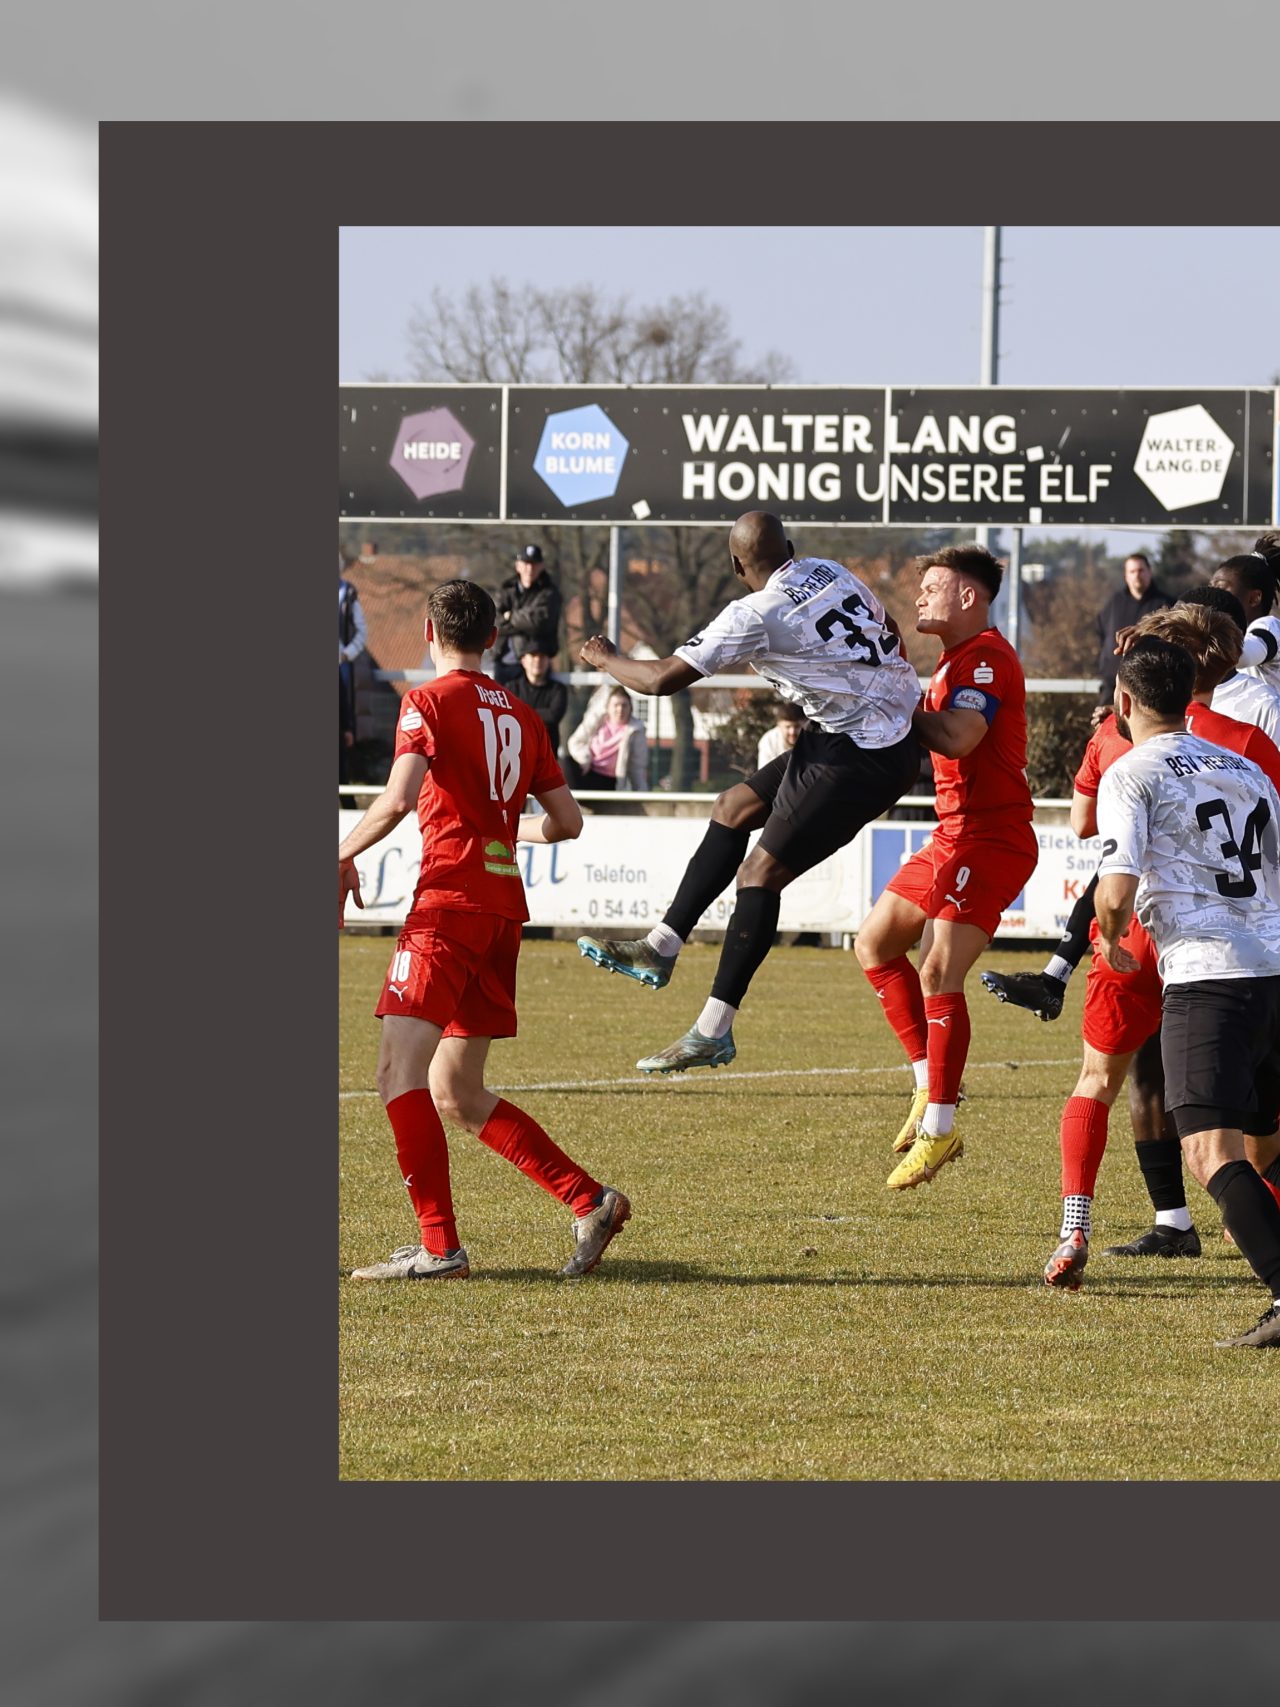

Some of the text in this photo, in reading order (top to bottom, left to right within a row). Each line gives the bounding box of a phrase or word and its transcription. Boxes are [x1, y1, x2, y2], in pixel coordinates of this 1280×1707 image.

[550, 431, 611, 451] KORN
[681, 413, 1017, 454] WALTER LANG
[403, 441, 461, 461] HEIDE
[1146, 437, 1224, 453] WALTER-
[545, 455, 616, 475] BLUME
[1145, 458, 1223, 474] LANG.DE
[681, 461, 1113, 504] HONIG UNSERE ELF
[477, 707, 522, 803] 18
[1165, 755, 1201, 778] BSV
[1195, 797, 1271, 899] 34
[584, 864, 647, 883] Telefon
[955, 866, 971, 892] 9
[588, 899, 599, 919] 0
[604, 899, 624, 919] 54
[629, 899, 650, 919] 43
[391, 950, 412, 983] 18
